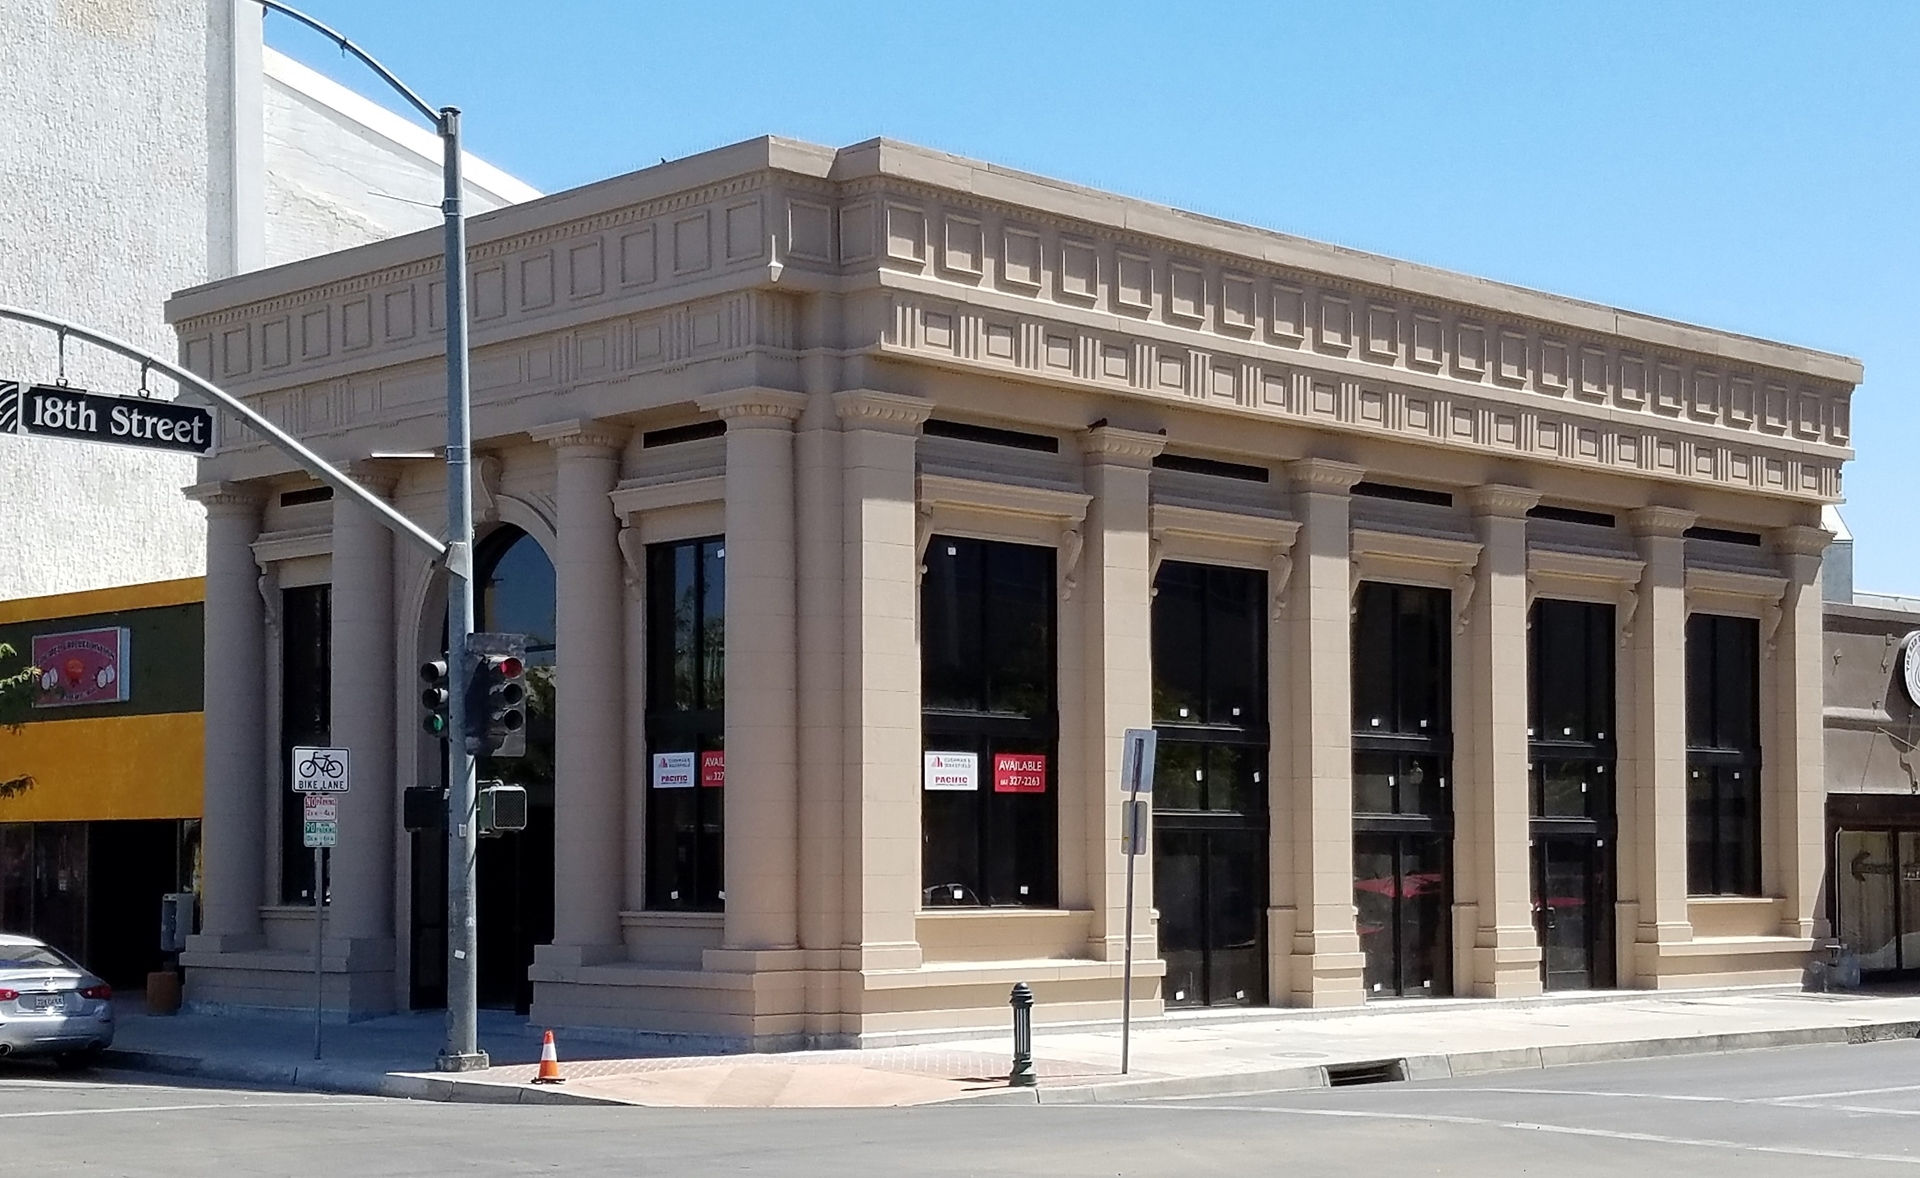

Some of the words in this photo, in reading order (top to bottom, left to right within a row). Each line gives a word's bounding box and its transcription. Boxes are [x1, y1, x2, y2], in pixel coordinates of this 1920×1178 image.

[33, 396, 97, 432] 18th
[109, 405, 205, 445] Street
[998, 759, 1042, 771] AVAILABLE
[299, 781, 318, 789] BIKE
[323, 781, 344, 789] LANE
[1009, 775, 1040, 786] 327-2263
[306, 796, 316, 807] NO
